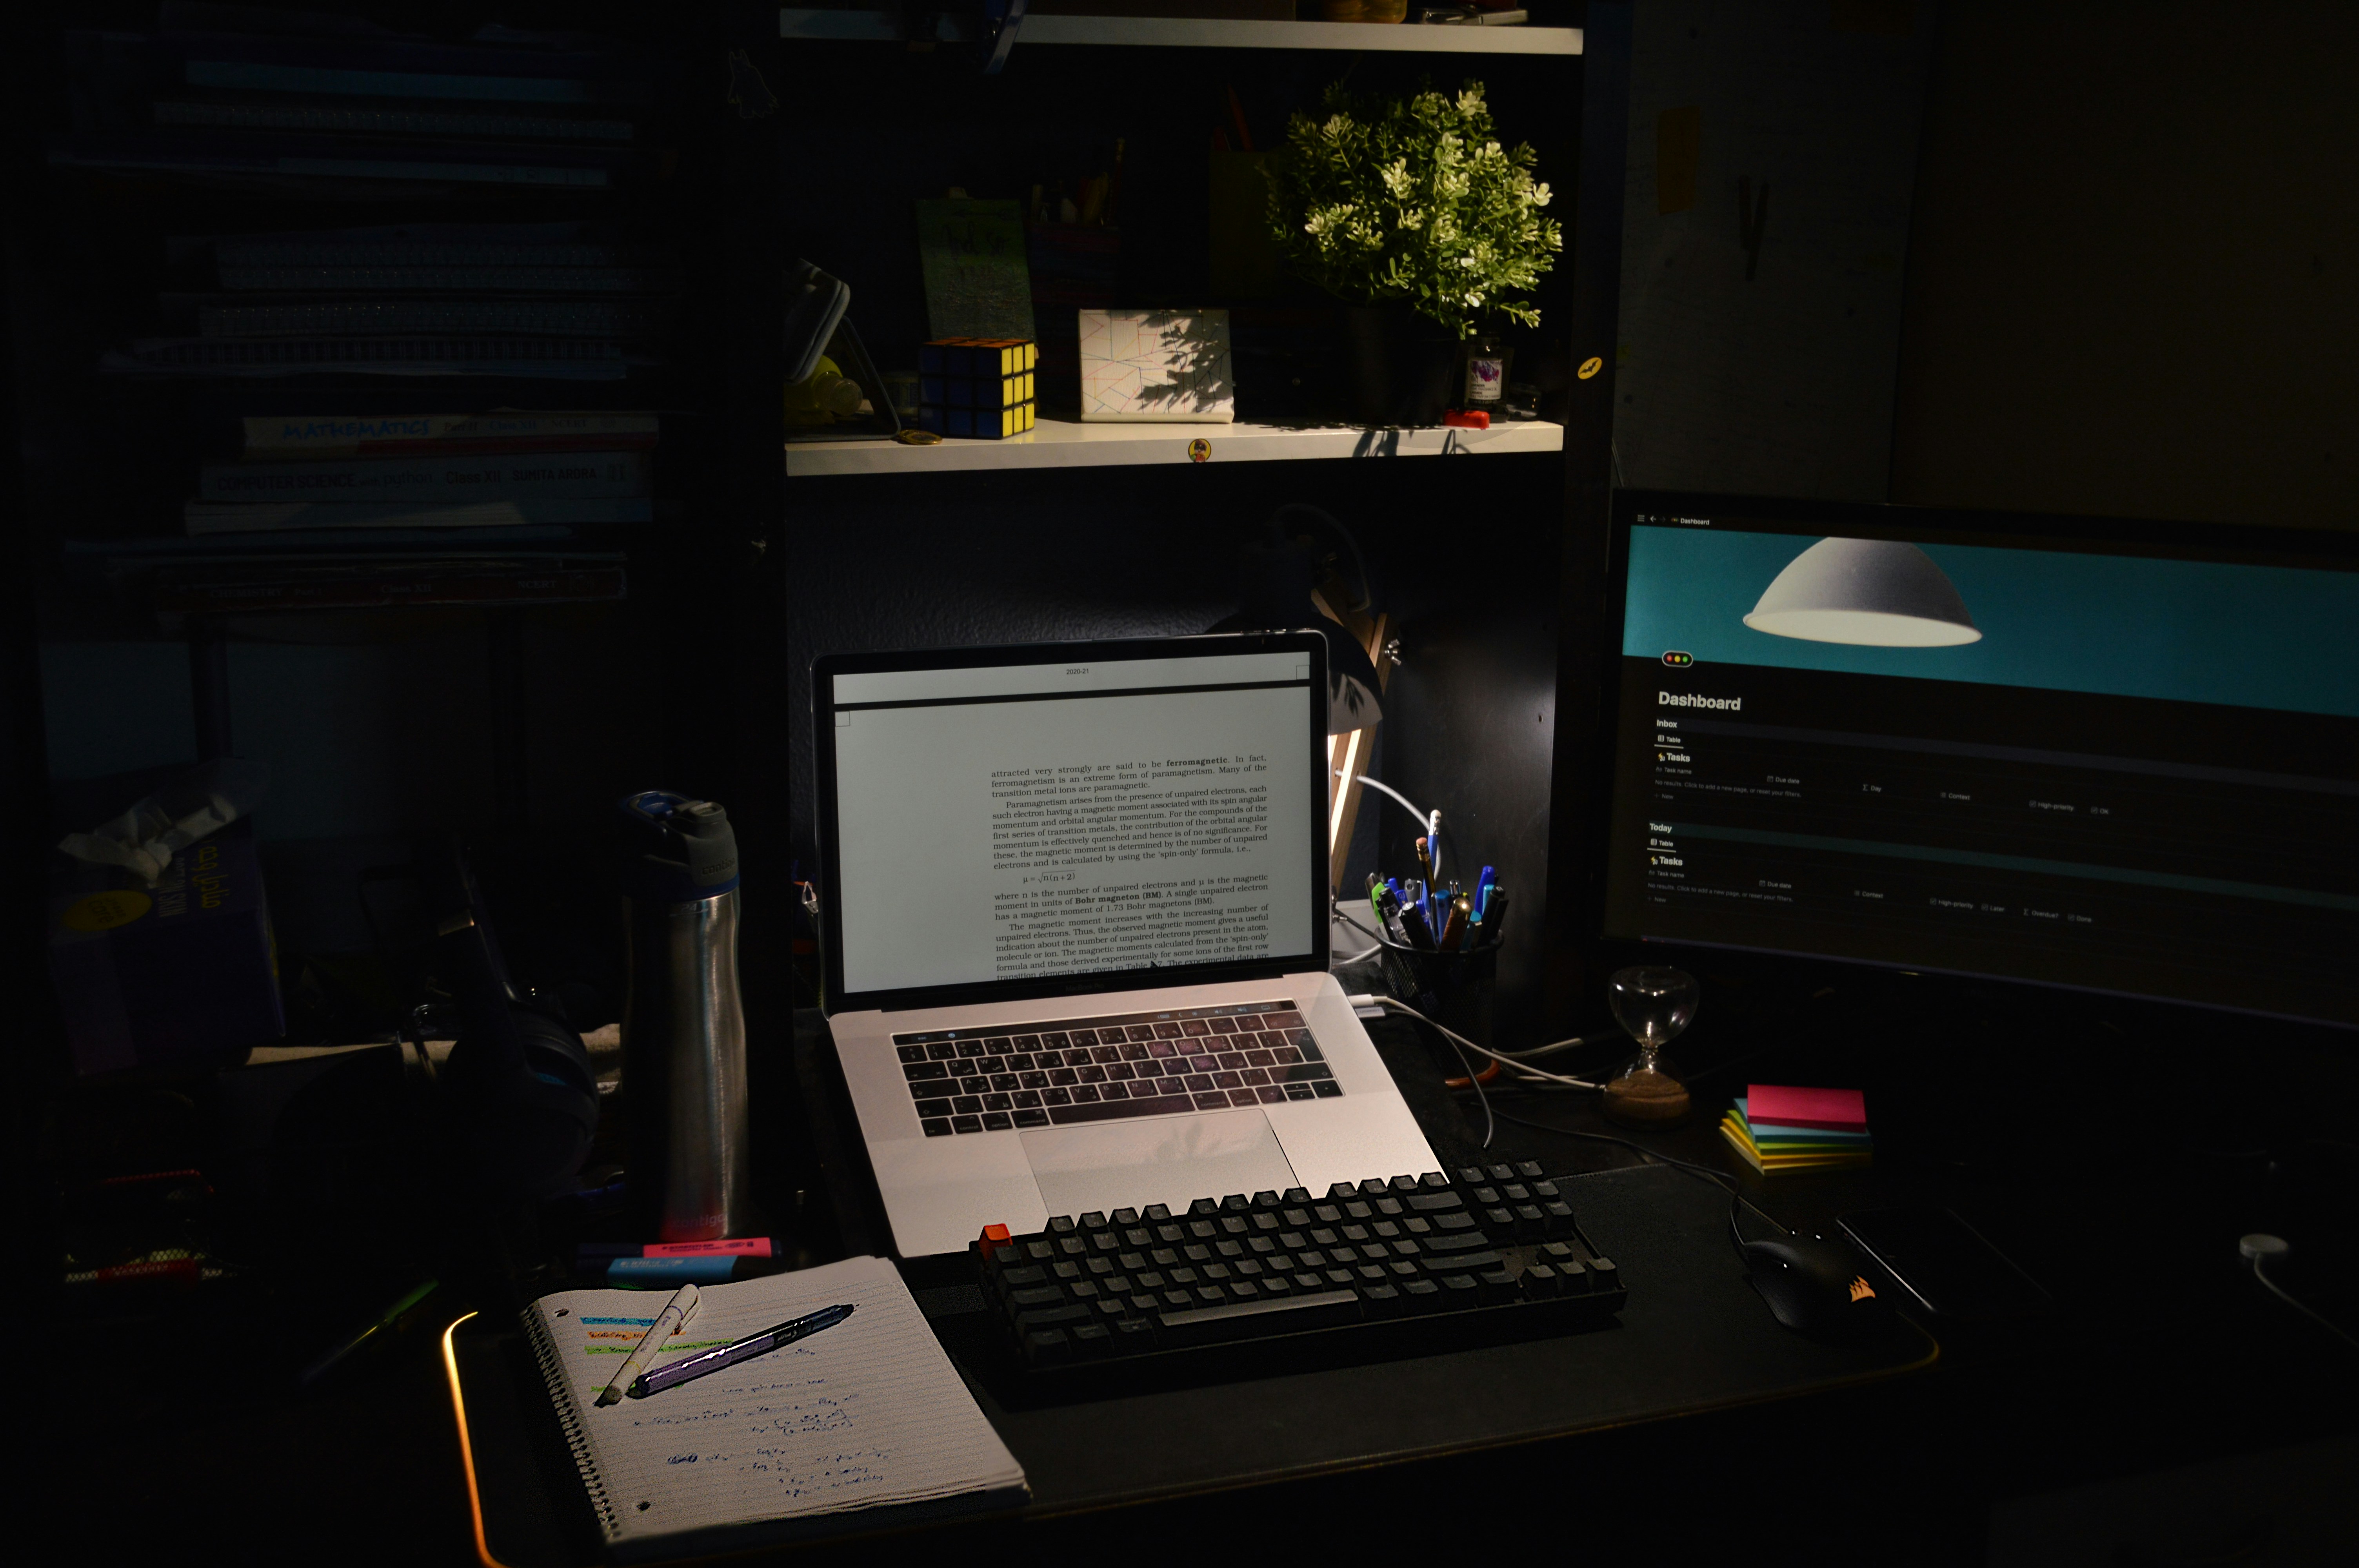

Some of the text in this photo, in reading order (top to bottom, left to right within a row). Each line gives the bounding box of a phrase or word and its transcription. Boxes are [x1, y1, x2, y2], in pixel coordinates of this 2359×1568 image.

[283, 419, 431, 439] MATHEMATICS
[490, 421, 517, 430] Class
[519, 420, 537, 429] XII
[218, 468, 597, 490] COMPUTER SCIENCE with python Class XII SUMITA ARORA
[211, 588, 283, 599] CHEMISTRY
[518, 579, 557, 590] NCERT
[1658, 691, 1741, 711] Dashboard
[1656, 719, 1677, 728] Inbox
[991, 768, 1030, 778] attracted
[1058, 764, 1092, 774] strongly
[1116, 762, 1133, 770] said
[1166, 756, 1230, 767] ferromagnetic.
[1666, 752, 1690, 762] Tasks
[991, 778, 1055, 788] ferromagnetism
[1151, 768, 1215, 779] paramagnetism.
[1219, 766, 1241, 774] Many
[1243, 764, 1252, 772] of
[991, 789, 1032, 798] transition
[1034, 786, 1057, 795] metal
[1094, 782, 1150, 793] paramagnetic.
[1006, 799, 1067, 809] Paramagnetism
[1129, 793, 1163, 802] presence
[1174, 788, 1209, 799] unpaired
[992, 811, 1012, 819] such
[1081, 805, 1116, 815] magnetic
[1117, 803, 1149, 811] moment
[1150, 799, 1189, 809] associated
[1220, 797, 1237, 806] spin
[1238, 795, 1268, 804] angular
[992, 821, 1039, 829] momentum
[1041, 818, 1056, 826] and
[1058, 816, 1084, 825] orbital
[1087, 815, 1118, 824] angular
[1119, 813, 1166, 821] momentum.
[1199, 806, 1244, 816] compounds
[1649, 822, 1672, 833] Today
[1659, 856, 1683, 866] Tasks
[681, 903, 698, 912] 24
